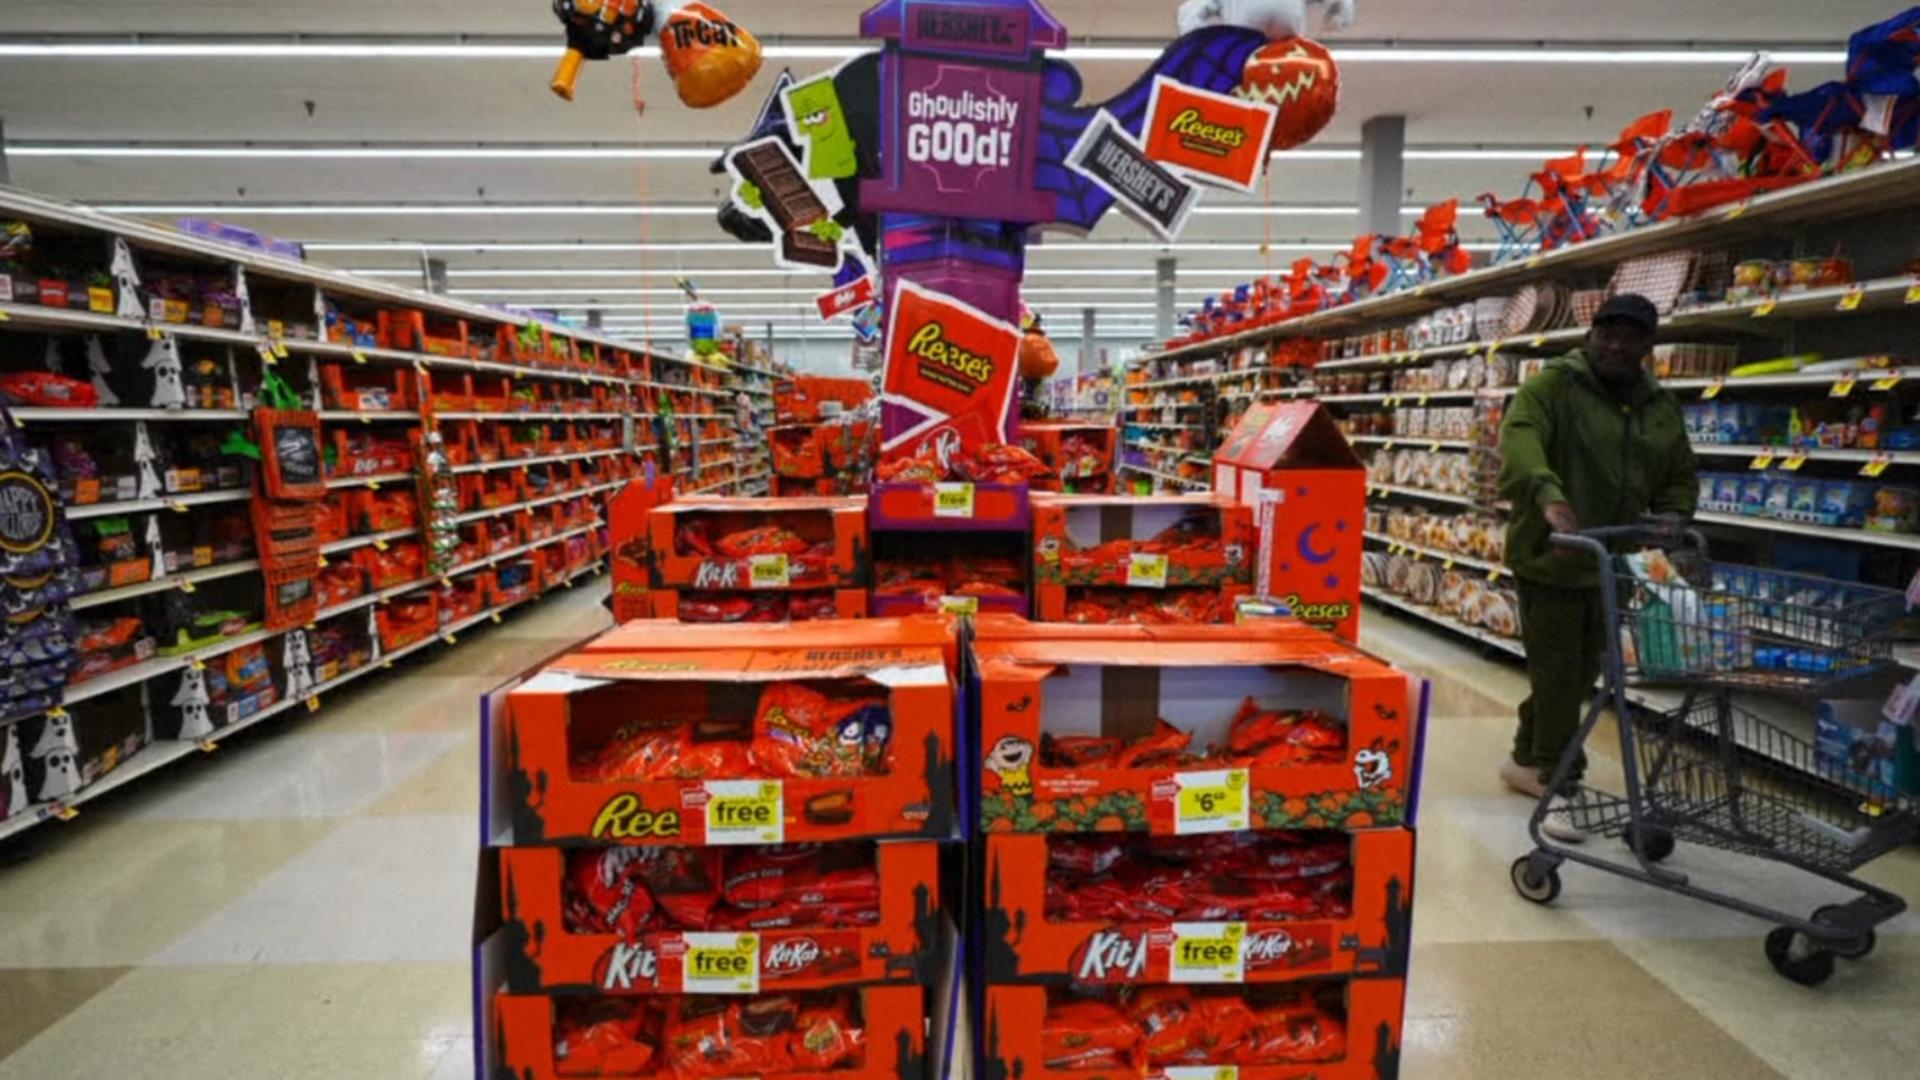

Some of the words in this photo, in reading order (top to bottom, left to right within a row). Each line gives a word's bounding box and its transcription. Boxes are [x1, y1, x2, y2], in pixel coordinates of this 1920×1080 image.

[908, 90, 1018, 128] Ghoulishly
[1169, 107, 1246, 147] Reese's
[1097, 139, 1176, 211] HERSHEY'S
[717, 801, 770, 822] free
[695, 953, 747, 971] free
[765, 942, 820, 969] KitKat
[1183, 941, 1234, 961] free
